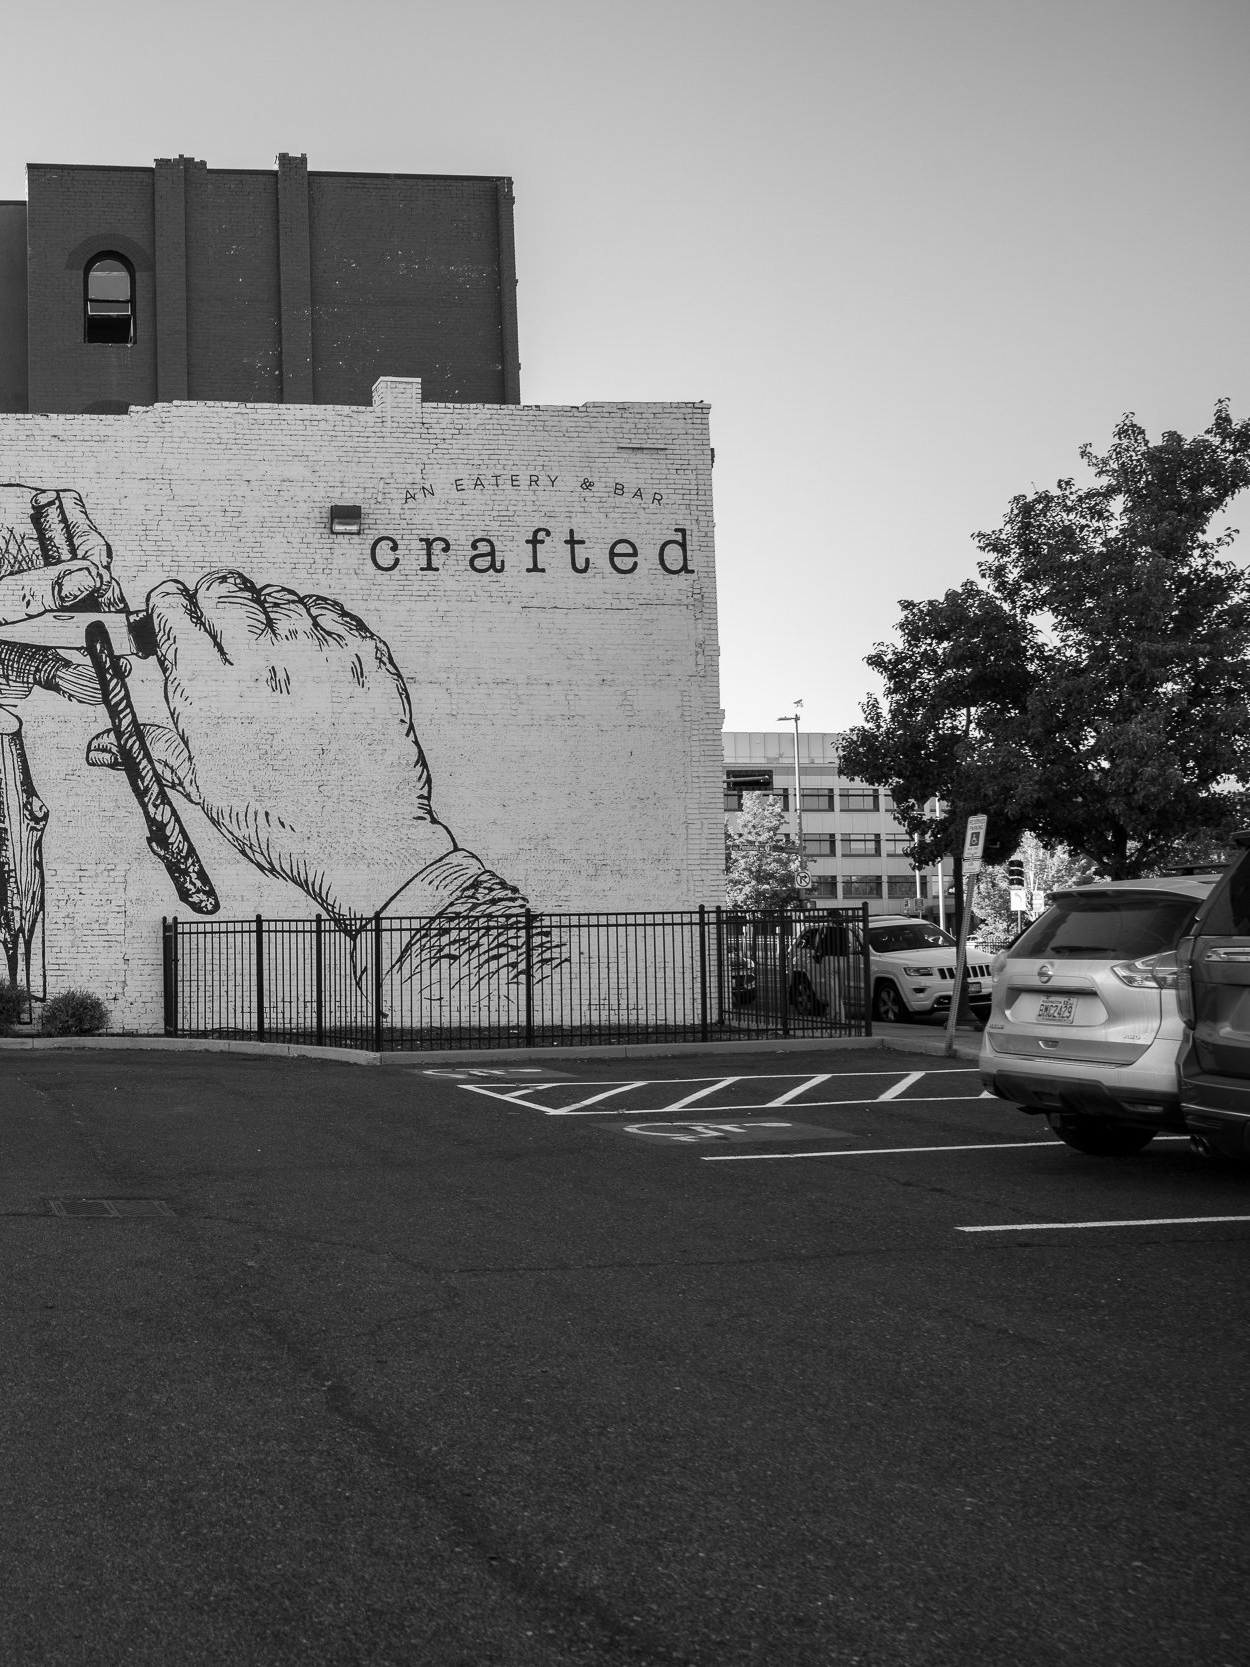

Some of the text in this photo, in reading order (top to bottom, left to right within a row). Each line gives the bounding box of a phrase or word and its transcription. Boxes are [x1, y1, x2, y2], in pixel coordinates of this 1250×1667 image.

[403, 474, 664, 507] AN EATERY & BAR
[370, 527, 696, 575] crafted
[1038, 1004, 1073, 1018] BMC2429
